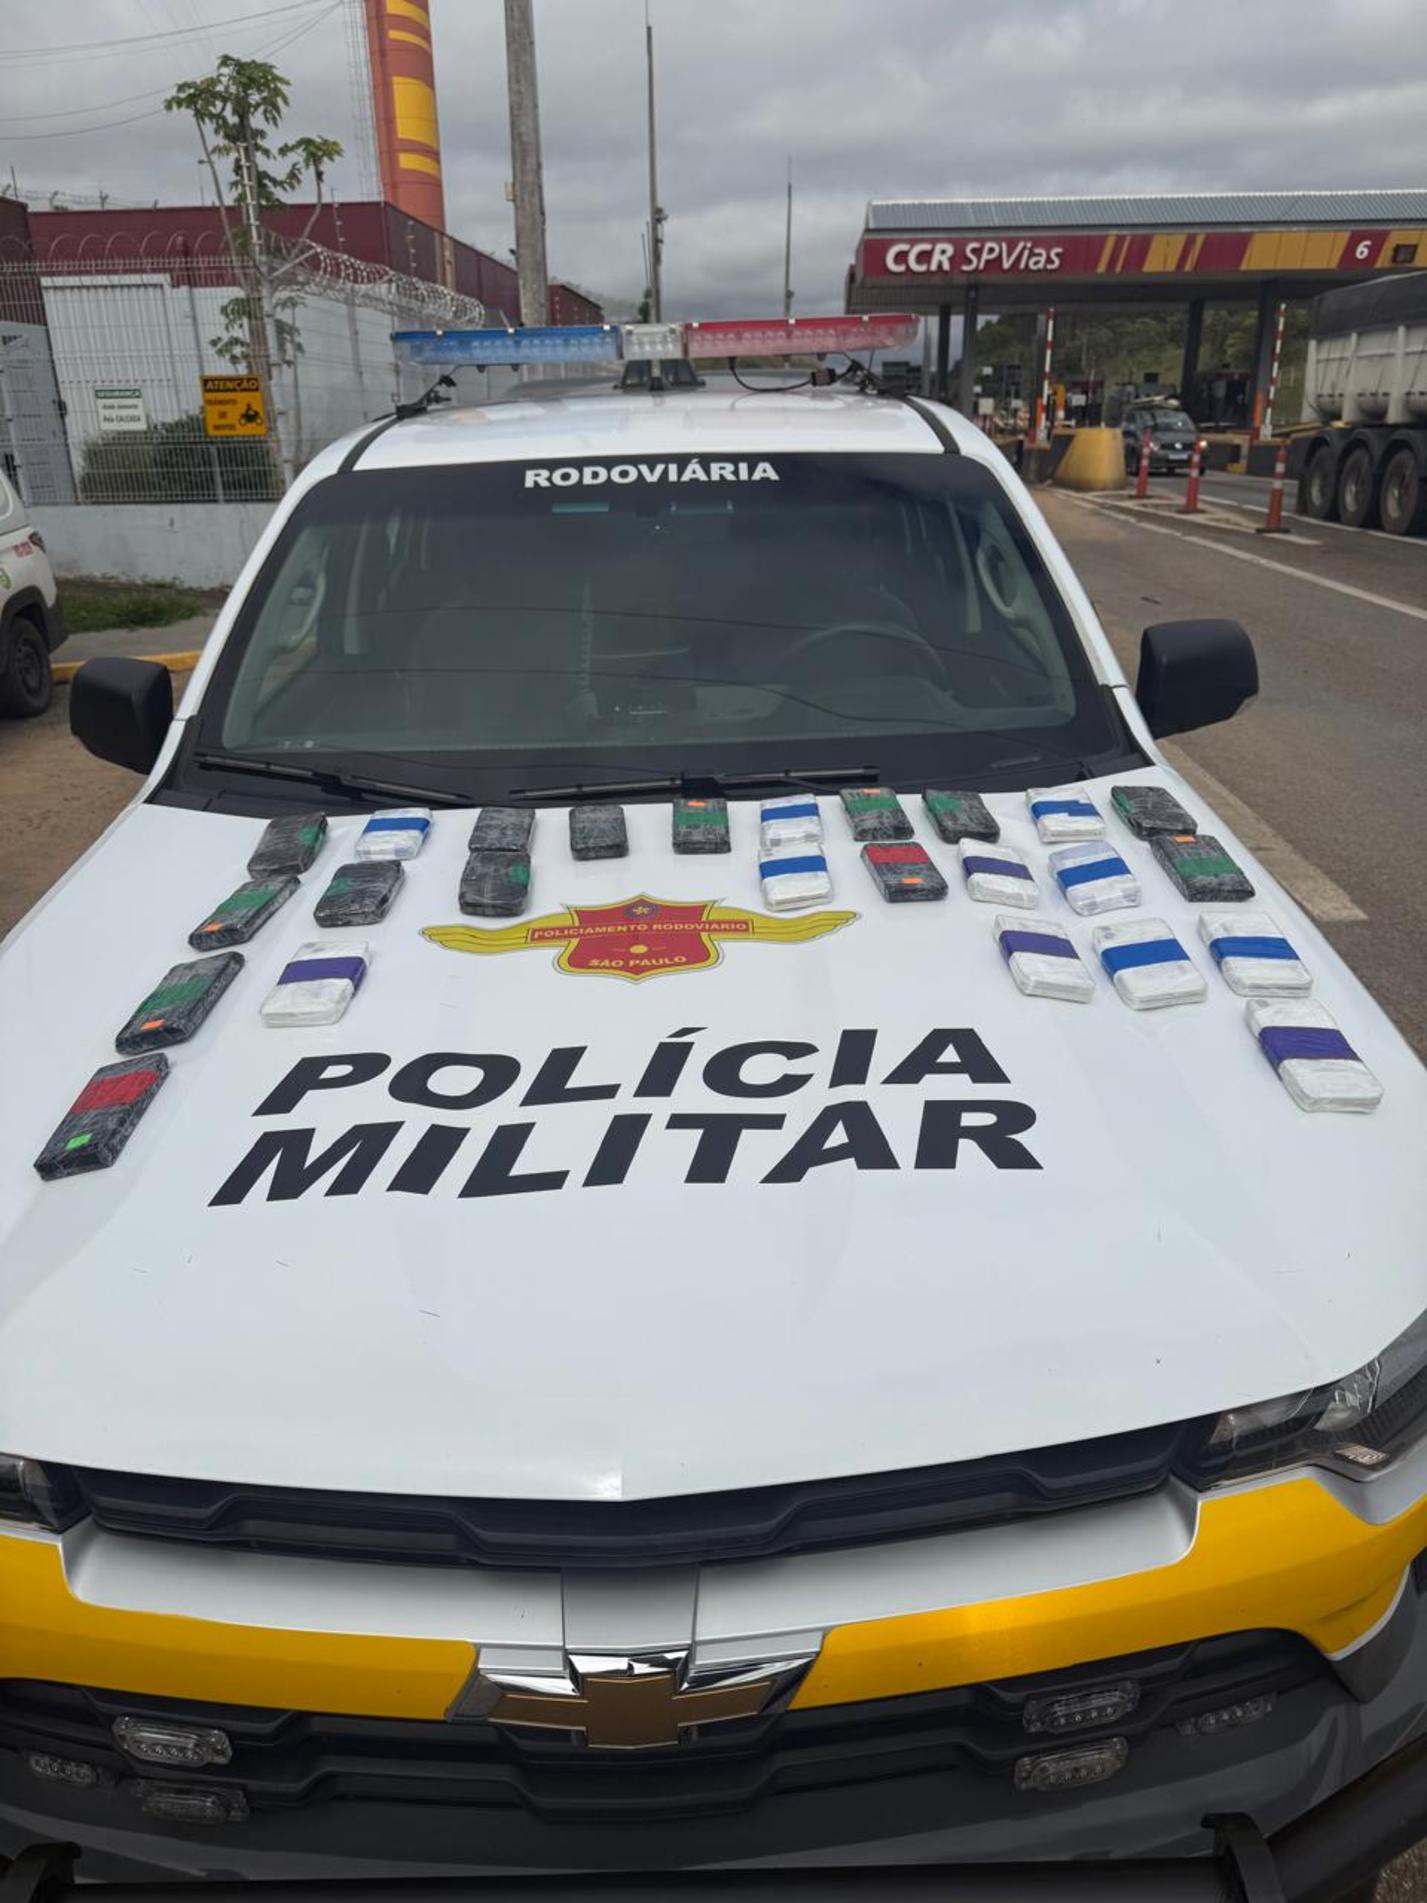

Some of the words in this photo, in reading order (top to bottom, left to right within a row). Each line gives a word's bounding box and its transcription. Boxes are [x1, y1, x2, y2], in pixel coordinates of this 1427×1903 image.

[885, 242, 955, 273] CCR
[960, 240, 1063, 272] SPVias
[1355, 240, 1372, 260] 6
[206, 379, 258, 391] ATENÇÃO
[524, 459, 780, 488] RODOVIÁRIA
[534, 923, 648, 939] POLICIAMENTO
[629, 956, 687, 967] PAULO
[252, 1027, 1012, 1117] POLÍCIA
[207, 1099, 1044, 1207] MILITAR
